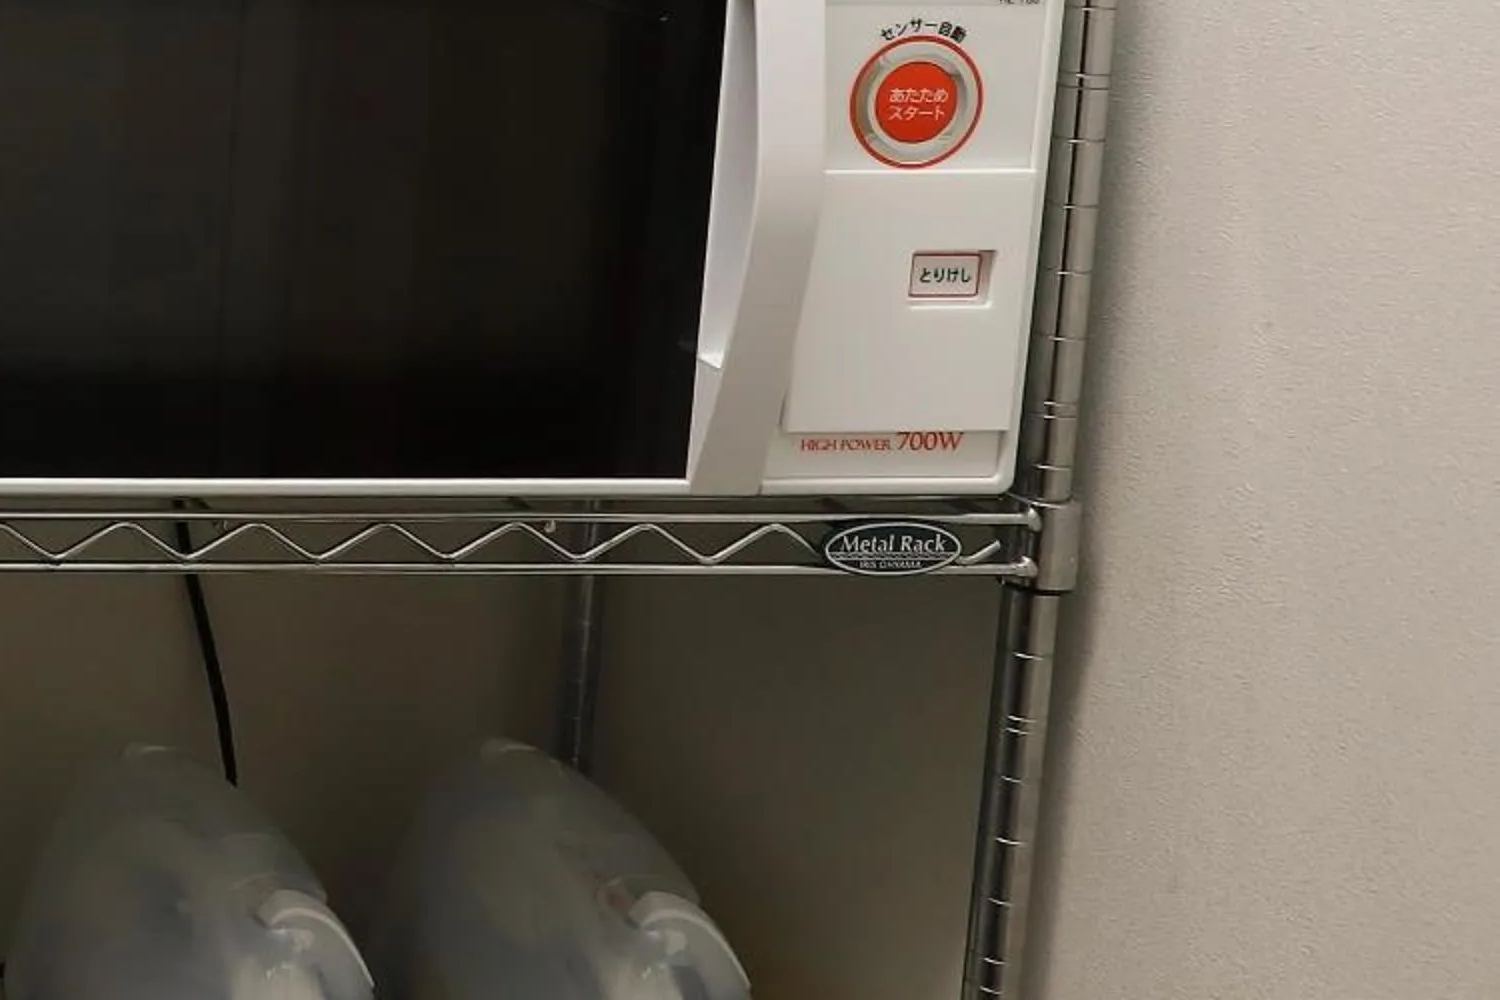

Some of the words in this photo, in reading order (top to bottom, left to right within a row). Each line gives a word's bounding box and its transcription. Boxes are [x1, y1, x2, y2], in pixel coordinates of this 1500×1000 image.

[880, 18, 967, 43] センサー自動
[889, 89, 948, 104] あたため
[888, 105, 946, 121] スタート
[919, 267, 971, 283] とりけし
[801, 439, 837, 451] HIGH
[841, 439, 891, 451] POWER
[896, 431, 965, 451] 700W
[841, 534, 895, 552] Metal
[901, 534, 947, 552] Rack
